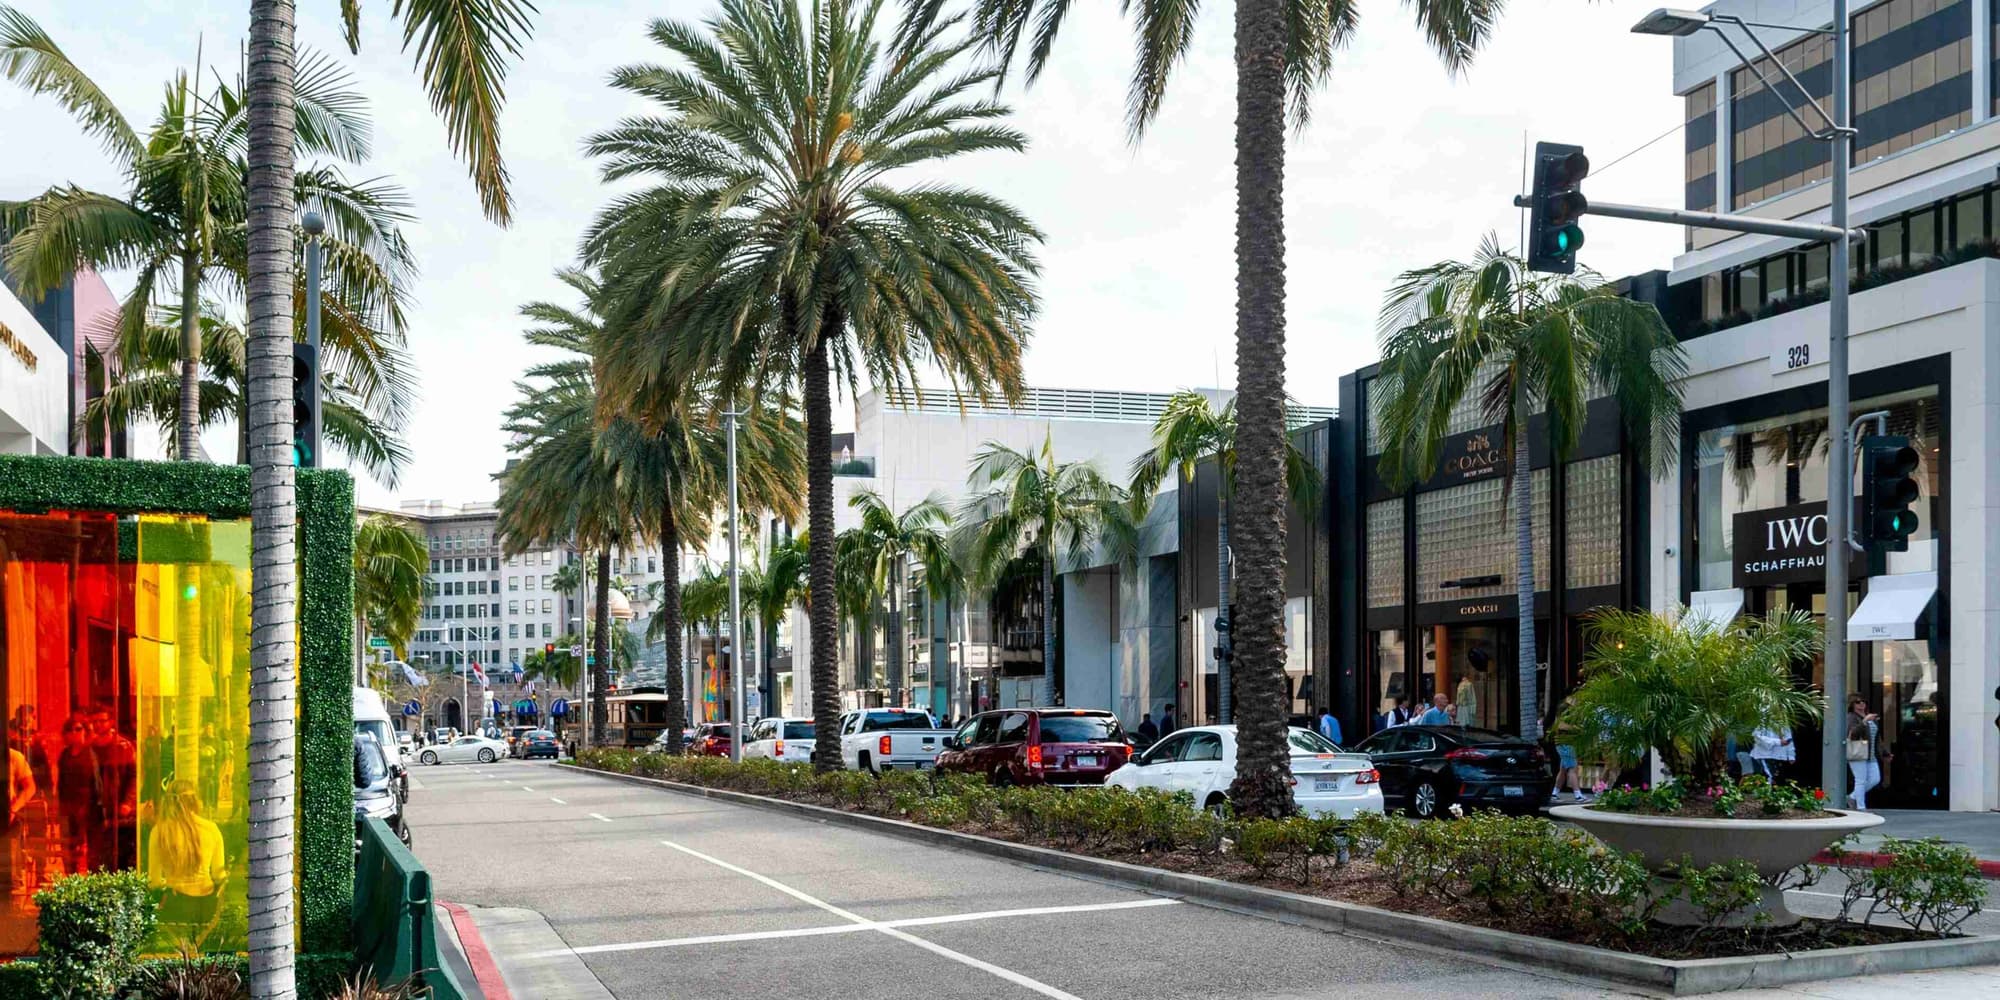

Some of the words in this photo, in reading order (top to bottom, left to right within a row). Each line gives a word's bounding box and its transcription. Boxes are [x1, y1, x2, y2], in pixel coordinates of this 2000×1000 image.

[1788, 344, 1809, 369] 329
[1445, 449, 1507, 475] COAC
[1766, 514, 1829, 551] IWC
[1744, 555, 1825, 573] SCHAFFHAU
[1460, 604, 1498, 615] COACH
[1871, 626, 1887, 634] IWC
